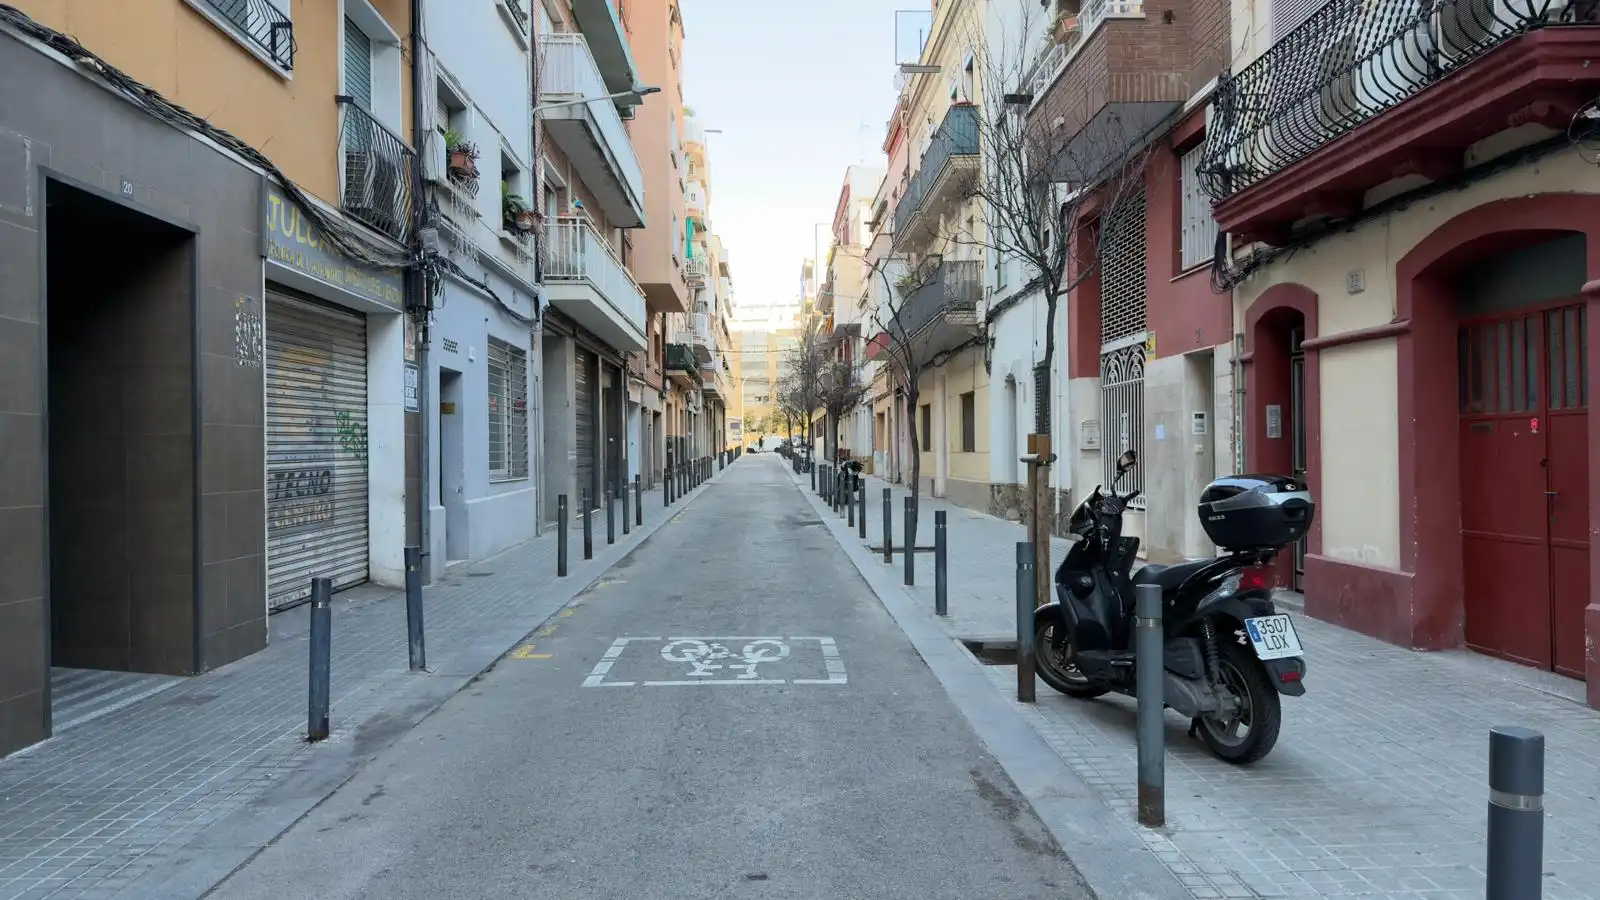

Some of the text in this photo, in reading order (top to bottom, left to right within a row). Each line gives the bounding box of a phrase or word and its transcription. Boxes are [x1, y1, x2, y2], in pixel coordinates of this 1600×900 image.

[123, 180, 133, 195] 20
[1257, 618, 1287, 635] 3507
[1263, 634, 1290, 651] LDX
